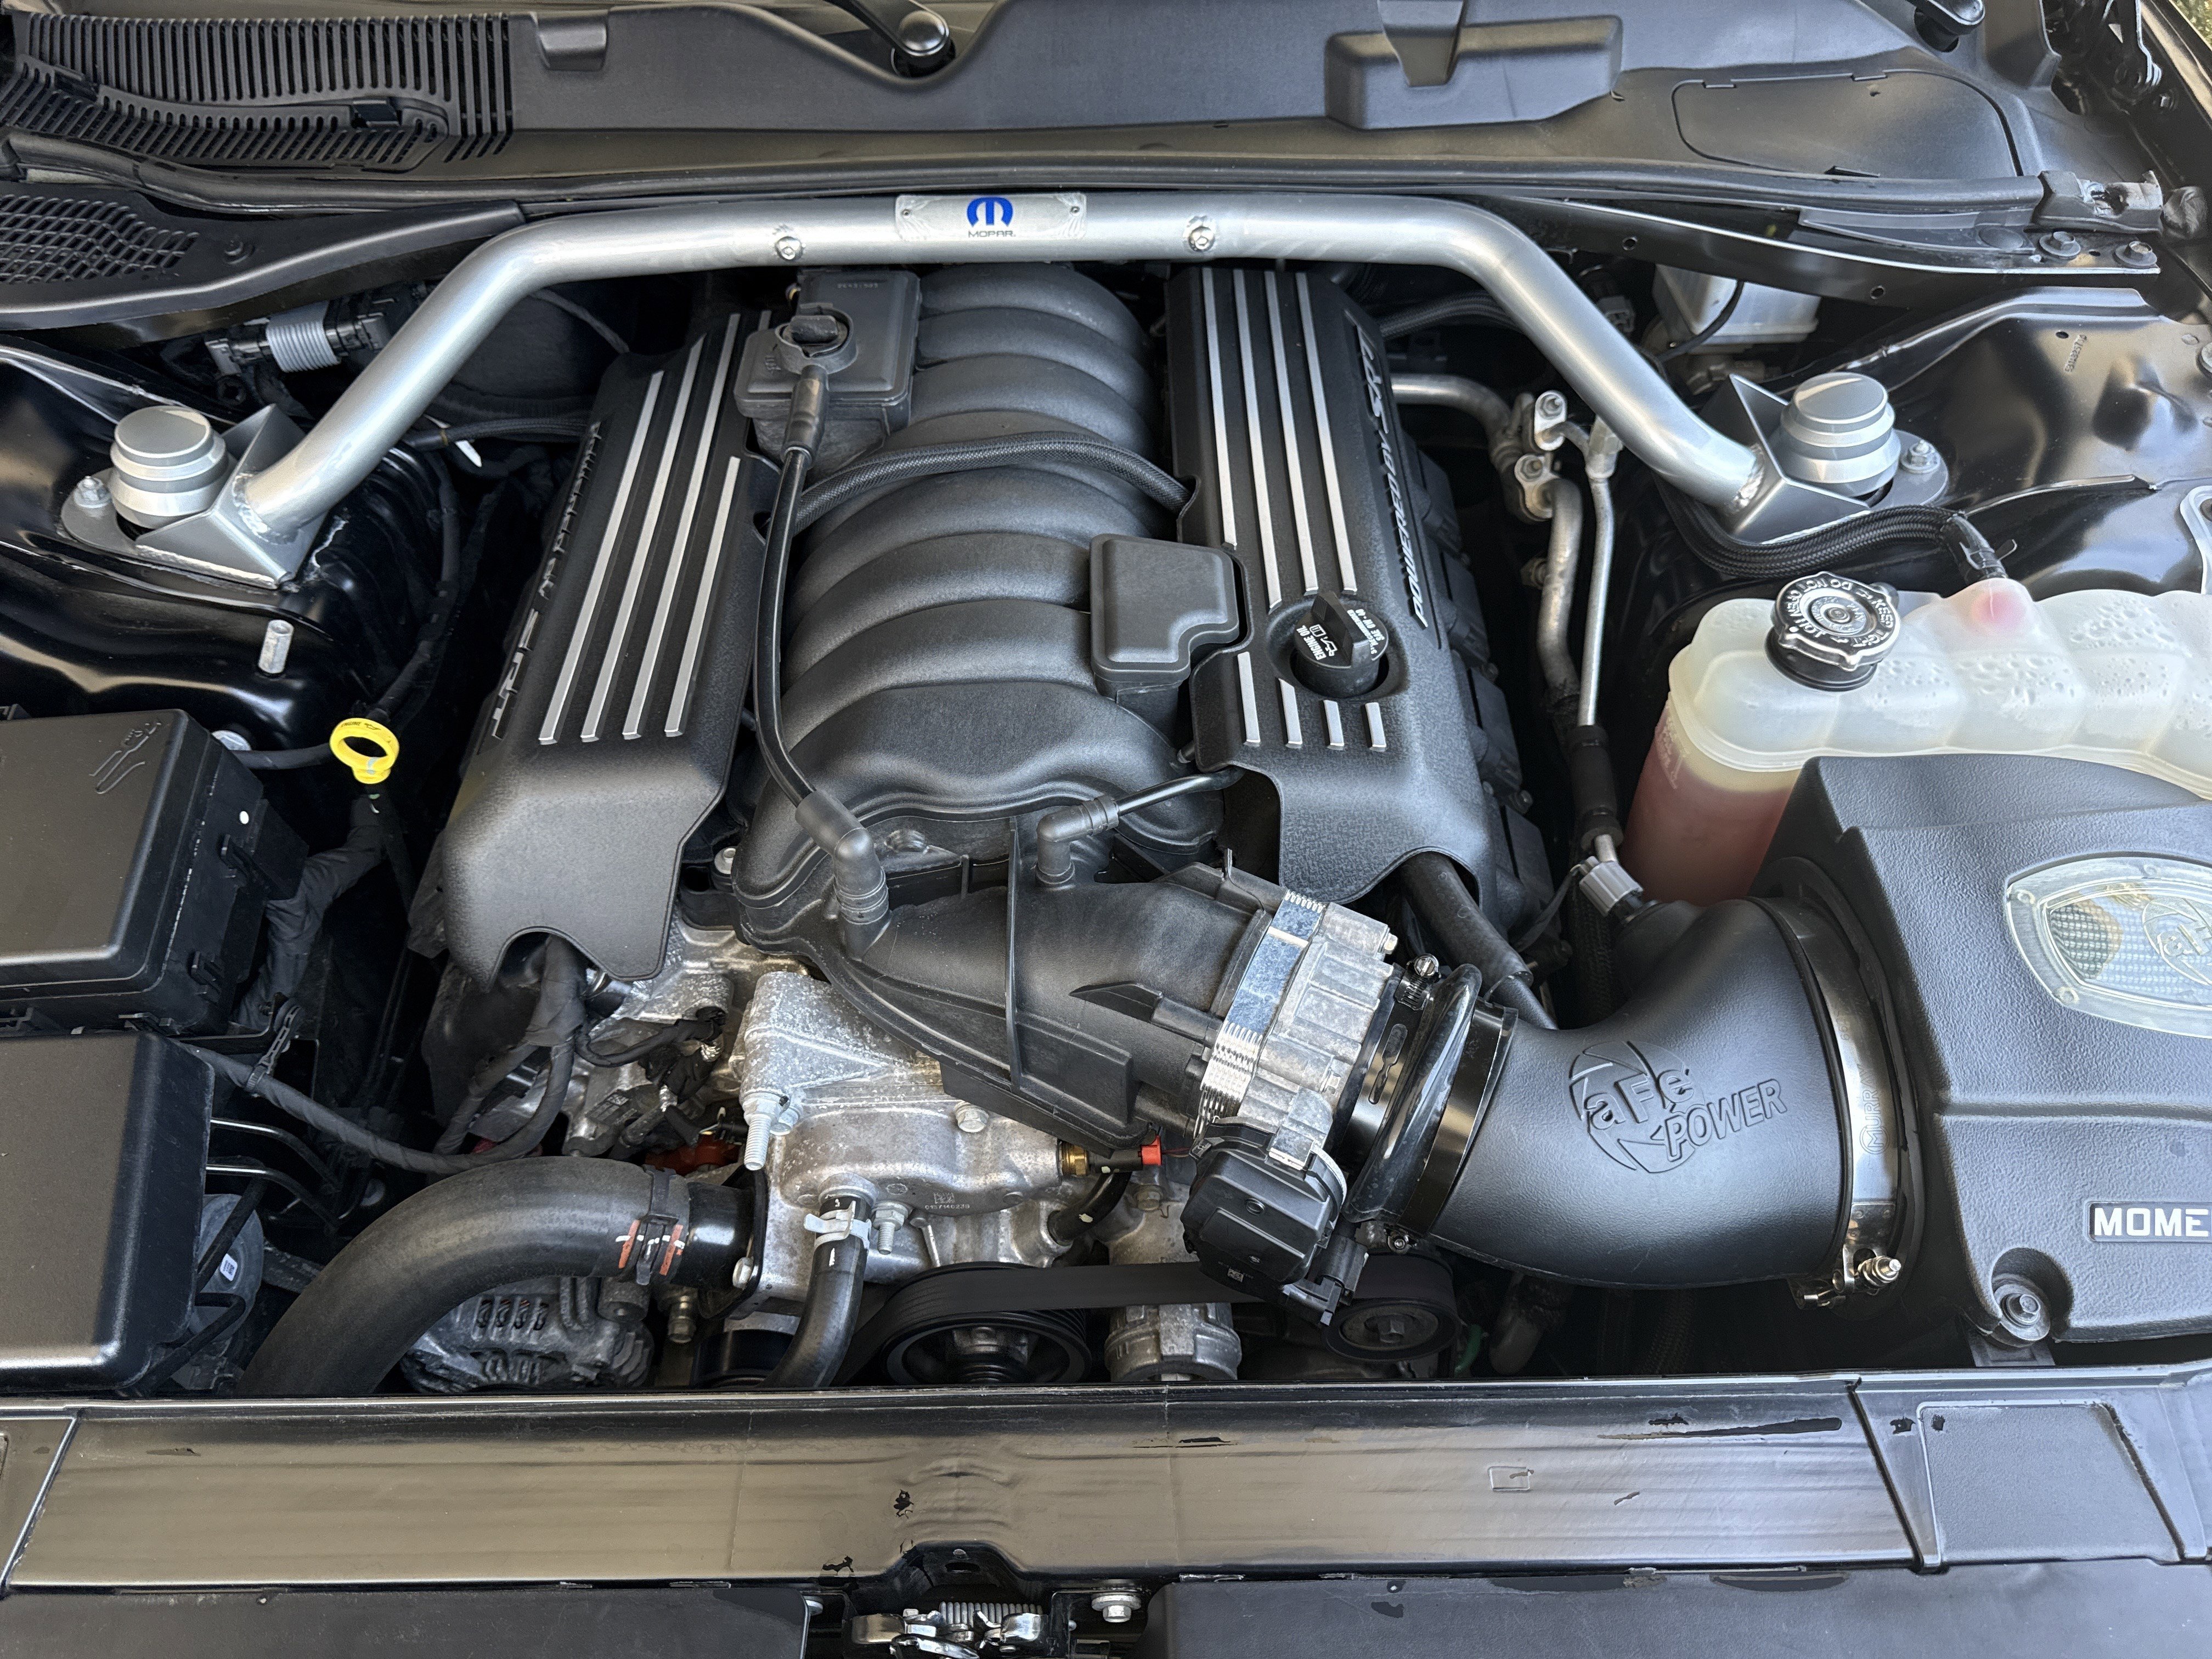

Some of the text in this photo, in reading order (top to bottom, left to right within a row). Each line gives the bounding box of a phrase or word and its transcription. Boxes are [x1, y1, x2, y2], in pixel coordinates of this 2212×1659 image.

[1356, 325, 1429, 628] POWERED BY SRT
[1796, 578, 1828, 593] NOT
[1830, 579, 1853, 591] DO
[1786, 590, 1802, 617] OPEN
[1871, 599, 1893, 629] KEEP
[1296, 624, 1327, 661] ENGINE OIL
[1371, 629, 1385, 642] SAE
[1584, 1068, 1788, 1163] aFe POWER
[1857, 1063, 1889, 1154] MURRAY
[2095, 1207, 2212, 1237] MOME
